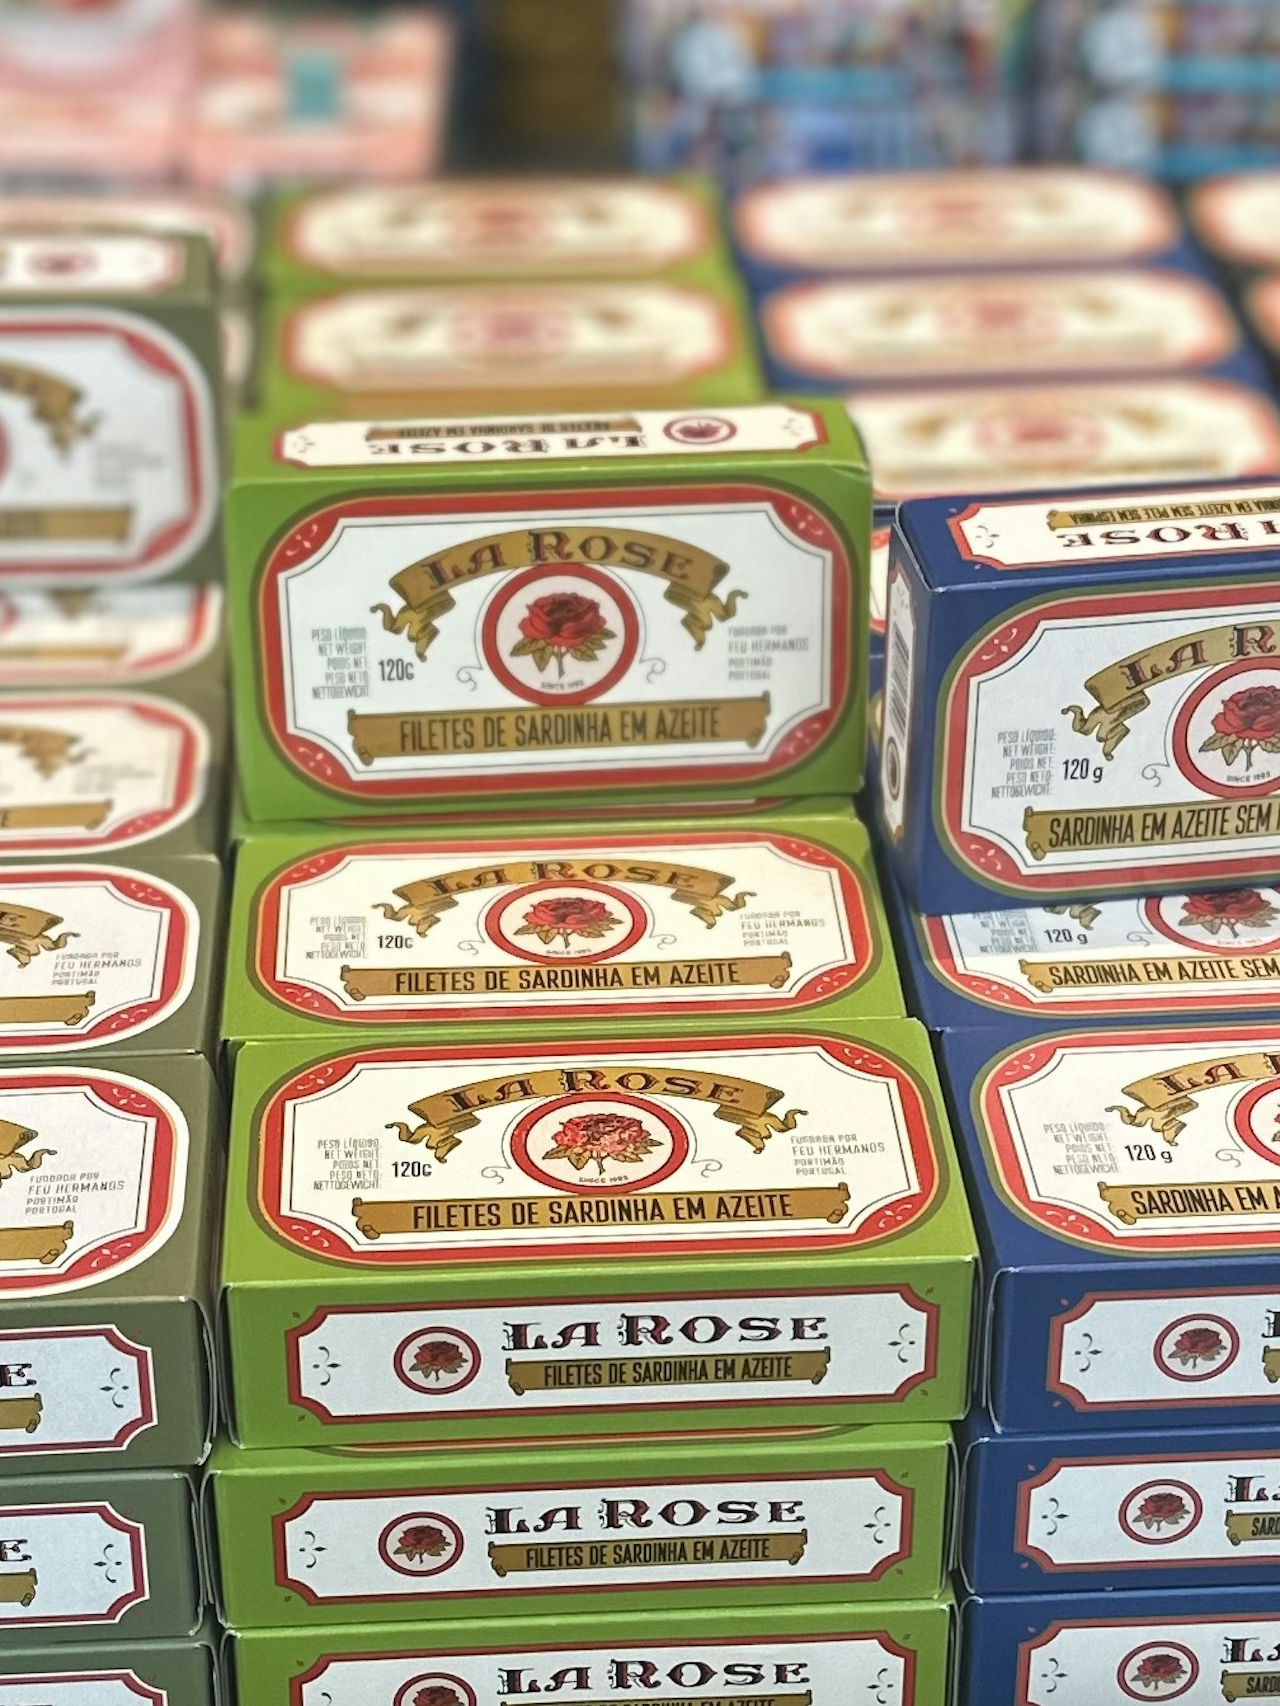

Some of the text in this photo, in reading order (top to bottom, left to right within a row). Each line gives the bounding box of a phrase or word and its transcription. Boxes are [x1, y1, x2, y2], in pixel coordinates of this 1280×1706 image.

[426, 532, 692, 589] LA ROSE
[1121, 642, 1207, 690] LA
[401, 708, 720, 751] FILETES DE SARDINHA EM AZEITE
[1049, 814, 1137, 847] SARDINHA
[1141, 813, 1168, 840] EM
[1173, 809, 1229, 839] AZEITE
[1235, 806, 1271, 834] SEM
[449, 1069, 743, 1113] LA ROSE
[1162, 1062, 1244, 1095] LA
[792, 1144, 815, 1155] FEU
[413, 1196, 793, 1229] FILETES DE SARDINHA EM AZEITE
[1131, 1189, 1229, 1215] SARDINHA
[1236, 1189, 1267, 1211] EM
[502, 1314, 828, 1351] LA ROSE
[544, 1357, 792, 1386] FILETES DE SARDINHA EM AZEITE
[498, 1659, 810, 1695] LA ROSE
